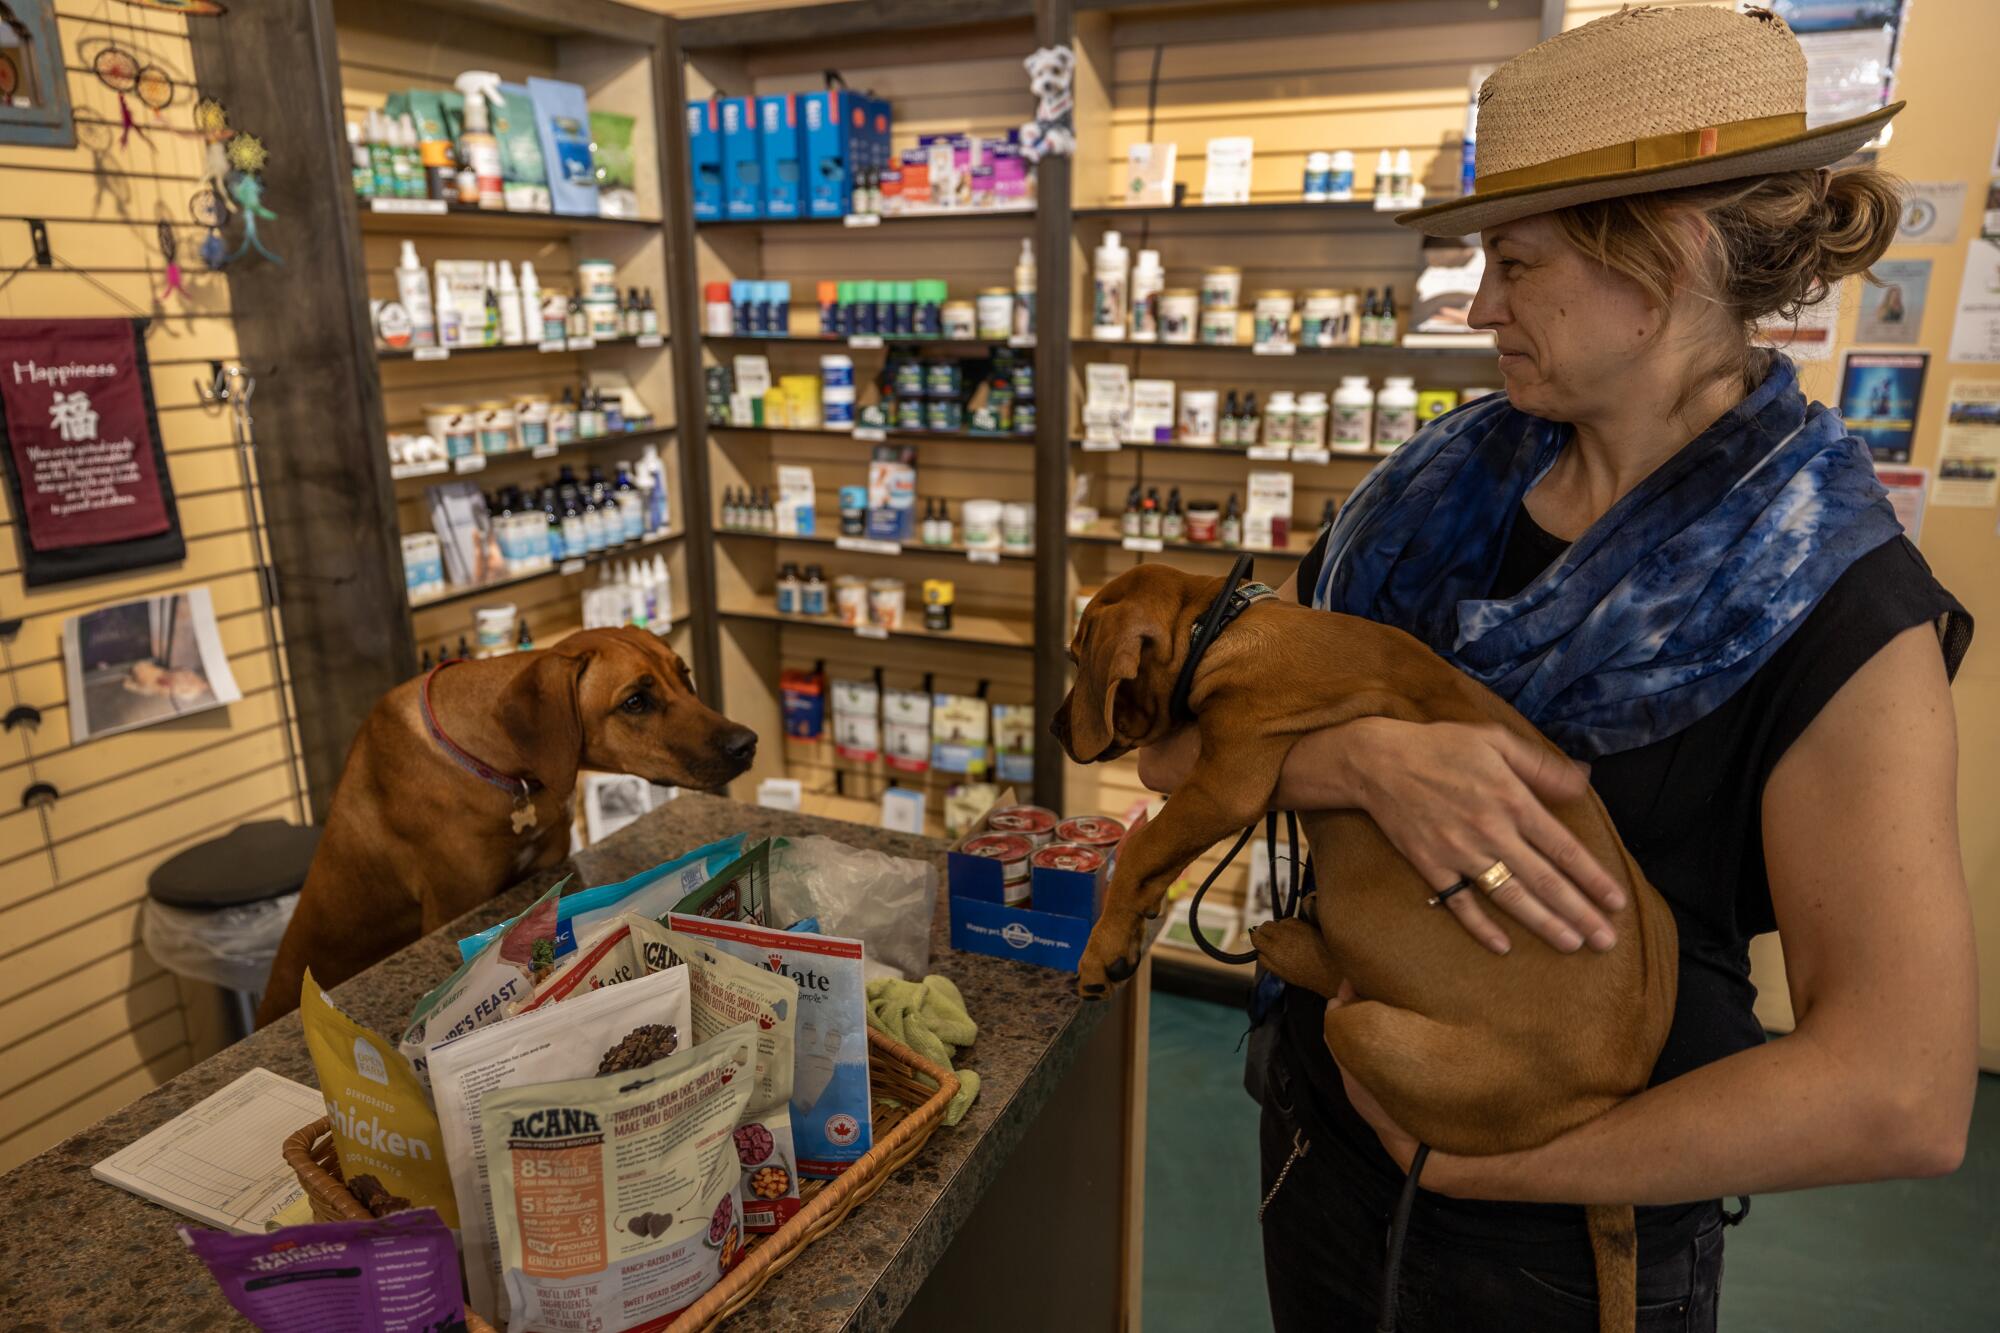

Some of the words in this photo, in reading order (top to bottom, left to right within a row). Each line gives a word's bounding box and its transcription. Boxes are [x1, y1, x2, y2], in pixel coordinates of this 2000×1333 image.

[13, 360, 117, 386] Happiness
[48, 391, 98, 441] 福
[754, 961, 830, 992] Mate
[474, 977, 518, 1021] FEAST
[724, 990, 736, 1003] DOG
[737, 996, 760, 1015] SHOULD
[725, 1003, 737, 1021] FEEL
[346, 1087, 396, 1113] DEHYDRATED
[614, 1100, 656, 1124] TREATING
[657, 1090, 679, 1110] YOUR
[679, 1082, 695, 1100] DOG
[695, 1068, 722, 1092] SHOULD
[510, 1107, 601, 1138] ACANA
[614, 1121, 641, 1138] MAKE
[643, 1113, 662, 1129] YOU
[663, 1104, 683, 1122] BOTH
[683, 1095, 699, 1111] FEEL
[566, 1136, 600, 1147] BISCUITS
[364, 1157, 402, 1177] TREATS
[520, 1159, 552, 1178] 85
[521, 1197, 535, 1212] 5
[557, 1240, 600, 1252] PROUDLY
[528, 1255, 566, 1267] KENTUCKY
[567, 1252, 601, 1265] KITCHEN
[621, 1254, 671, 1276] RANCH-RAISED
[671, 1247, 687, 1260] BEEF
[563, 1287, 581, 1298] LOVE
[585, 1285, 599, 1296] THE
[623, 1296, 645, 1309] SWEET
[646, 1287, 670, 1302] POTATO
[572, 1308, 591, 1318] LOVE
